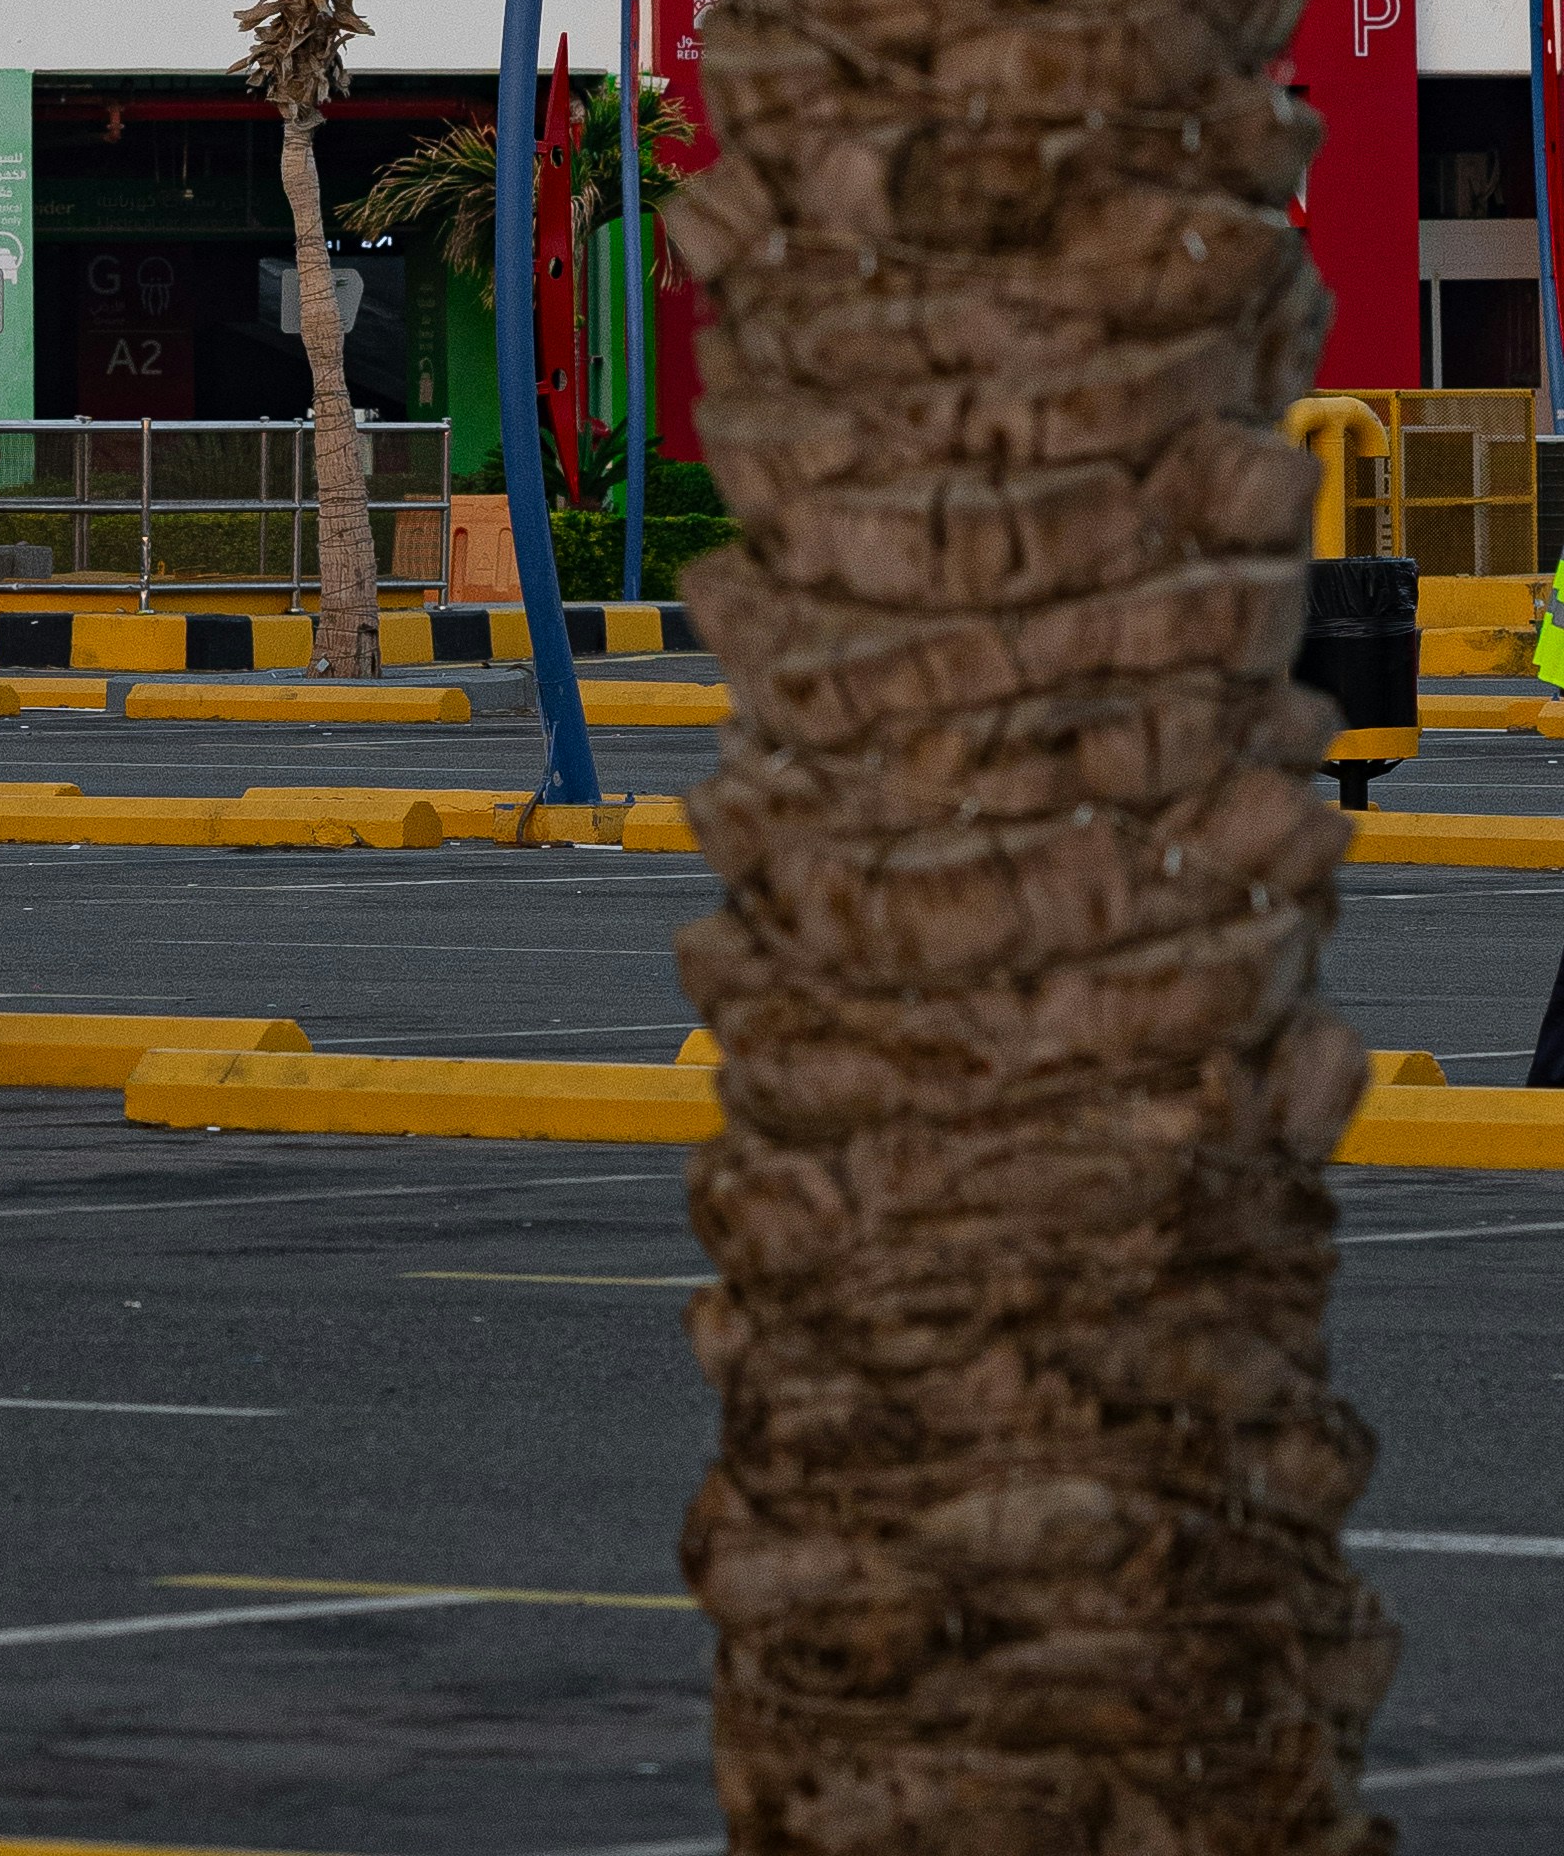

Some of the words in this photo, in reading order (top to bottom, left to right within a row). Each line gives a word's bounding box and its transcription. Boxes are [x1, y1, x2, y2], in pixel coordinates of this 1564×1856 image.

[677, 34, 706, 48] ول
[676, 50, 699, 60] RED
[88, 254, 122, 295] G
[105, 336, 164, 376] A2
